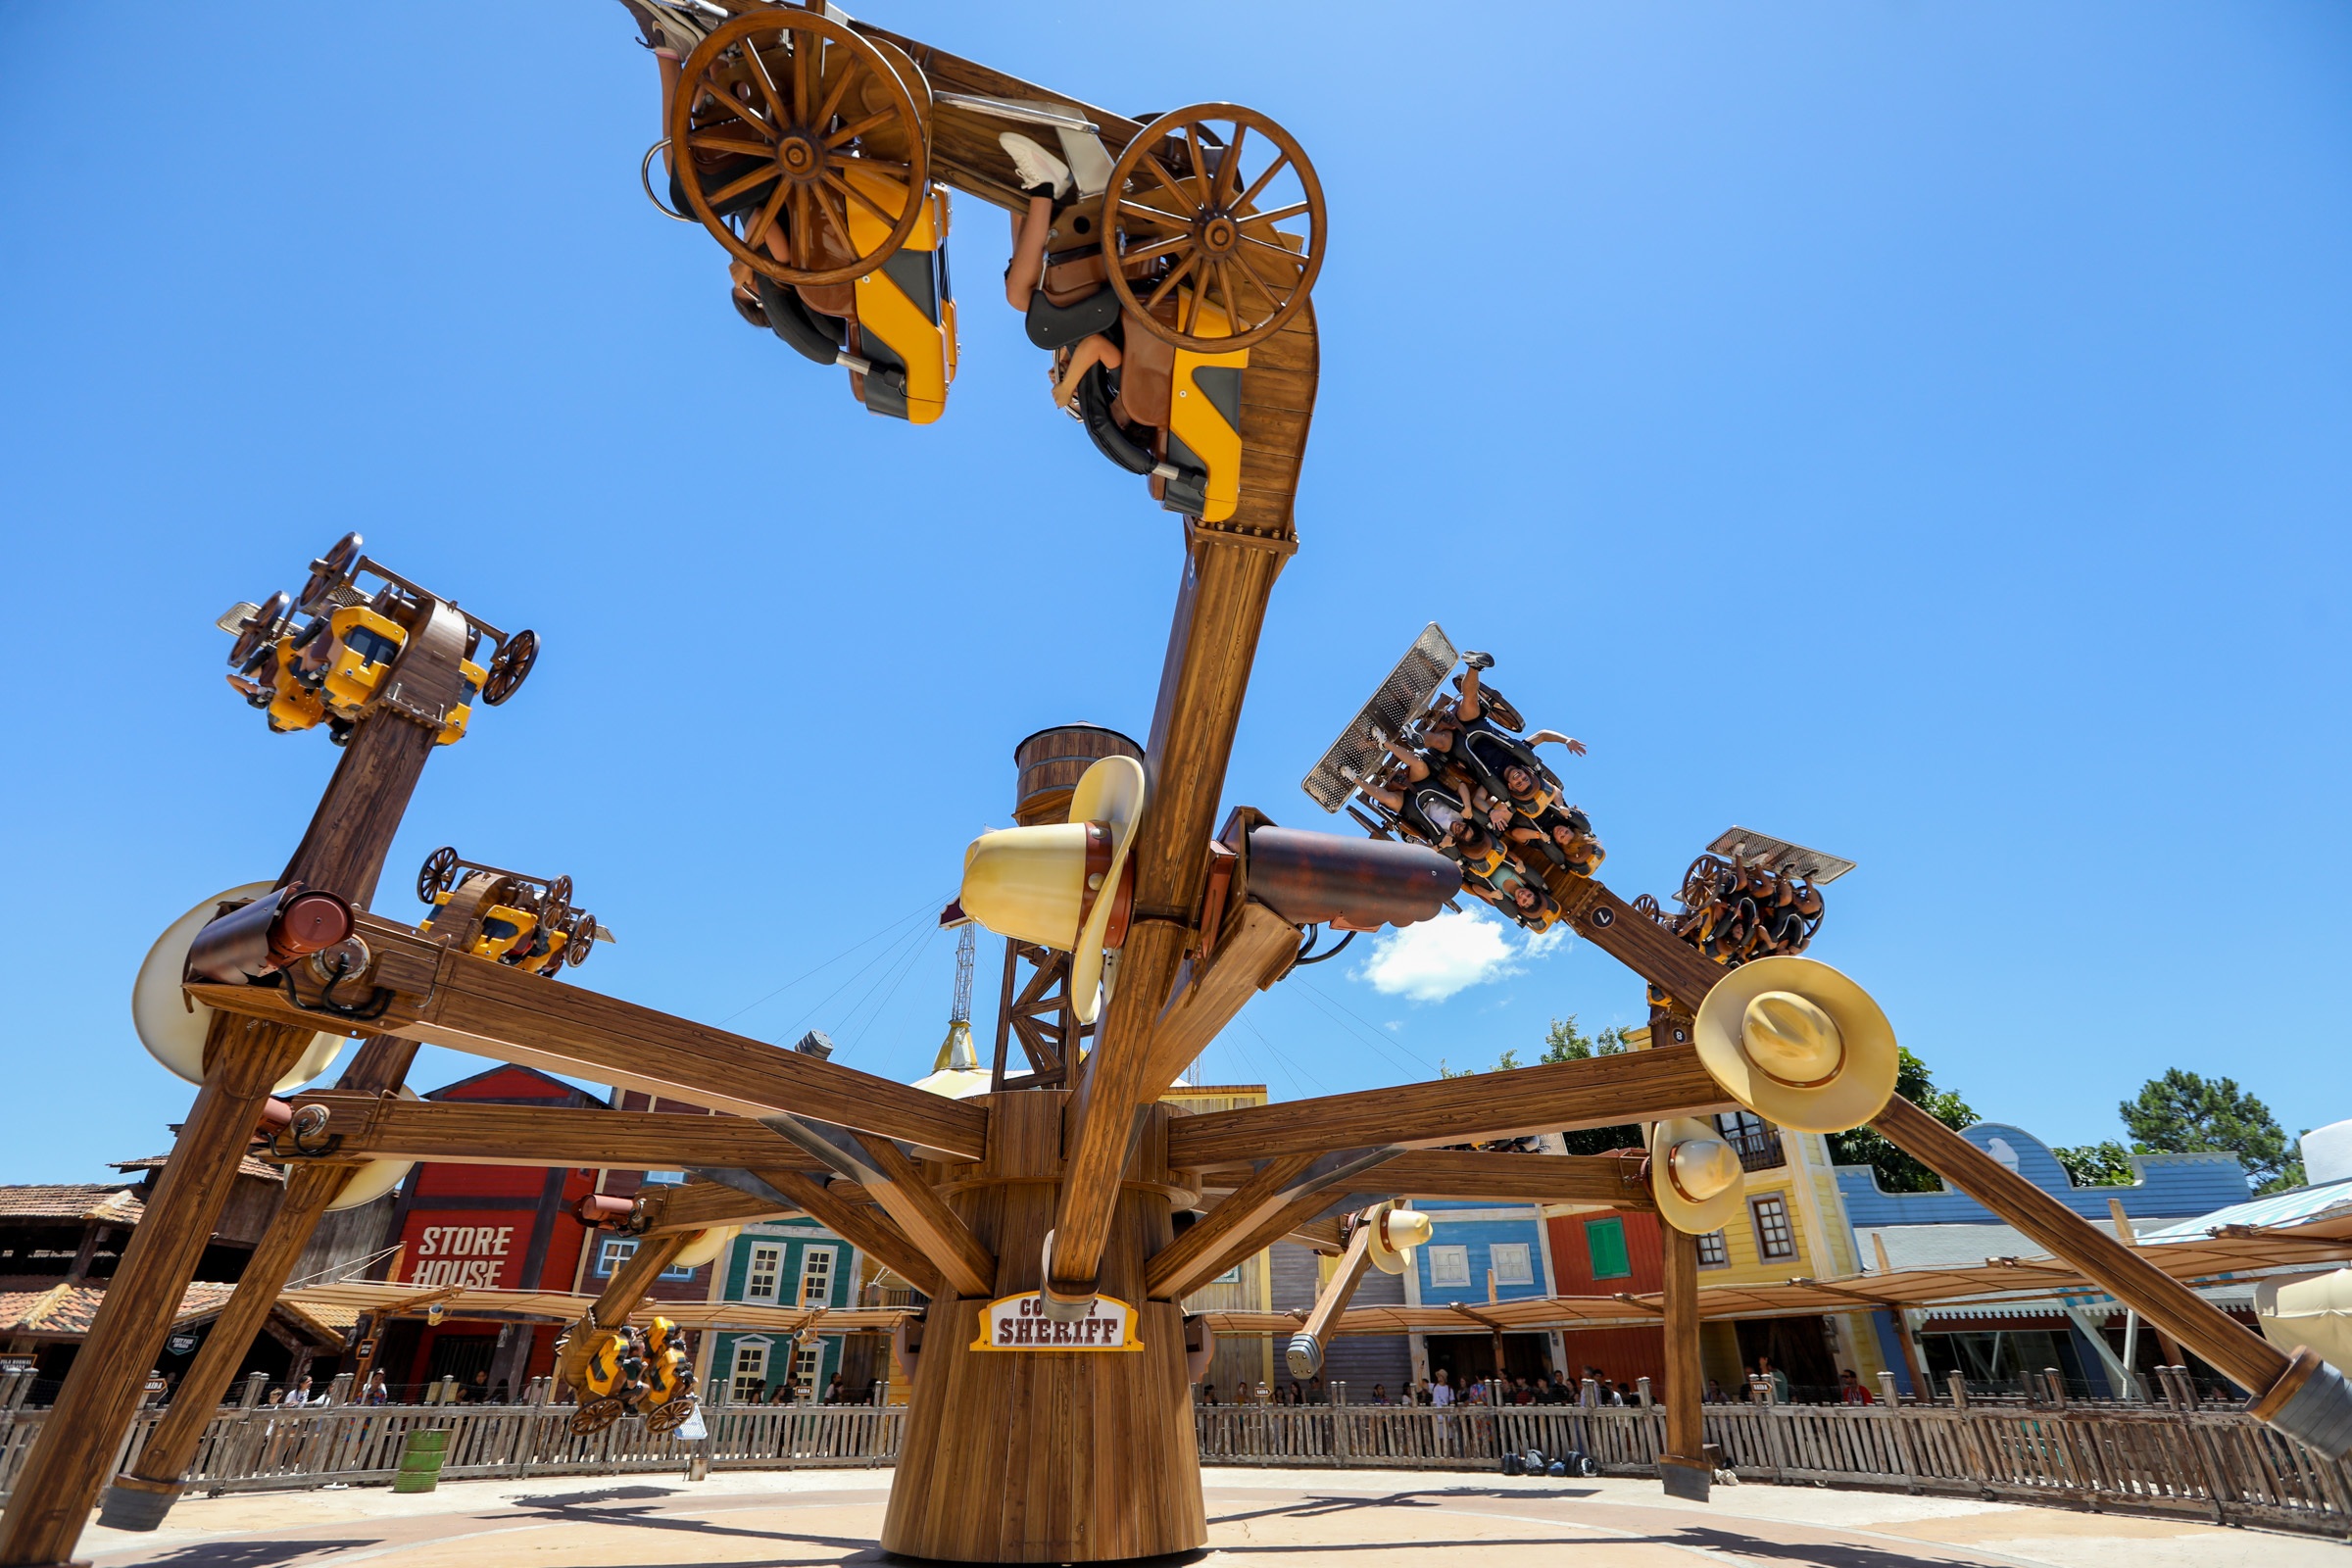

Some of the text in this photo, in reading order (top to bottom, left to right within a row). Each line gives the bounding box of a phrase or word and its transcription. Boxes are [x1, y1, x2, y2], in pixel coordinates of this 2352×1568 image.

[1598, 911, 1610, 924] 7
[1676, 1031, 1683, 1041] 8
[417, 1226, 514, 1255] STORE
[412, 1260, 505, 1290] HOUSE
[1020, 1298, 1099, 1318] COY
[998, 1318, 1118, 1345] SHERIFF
